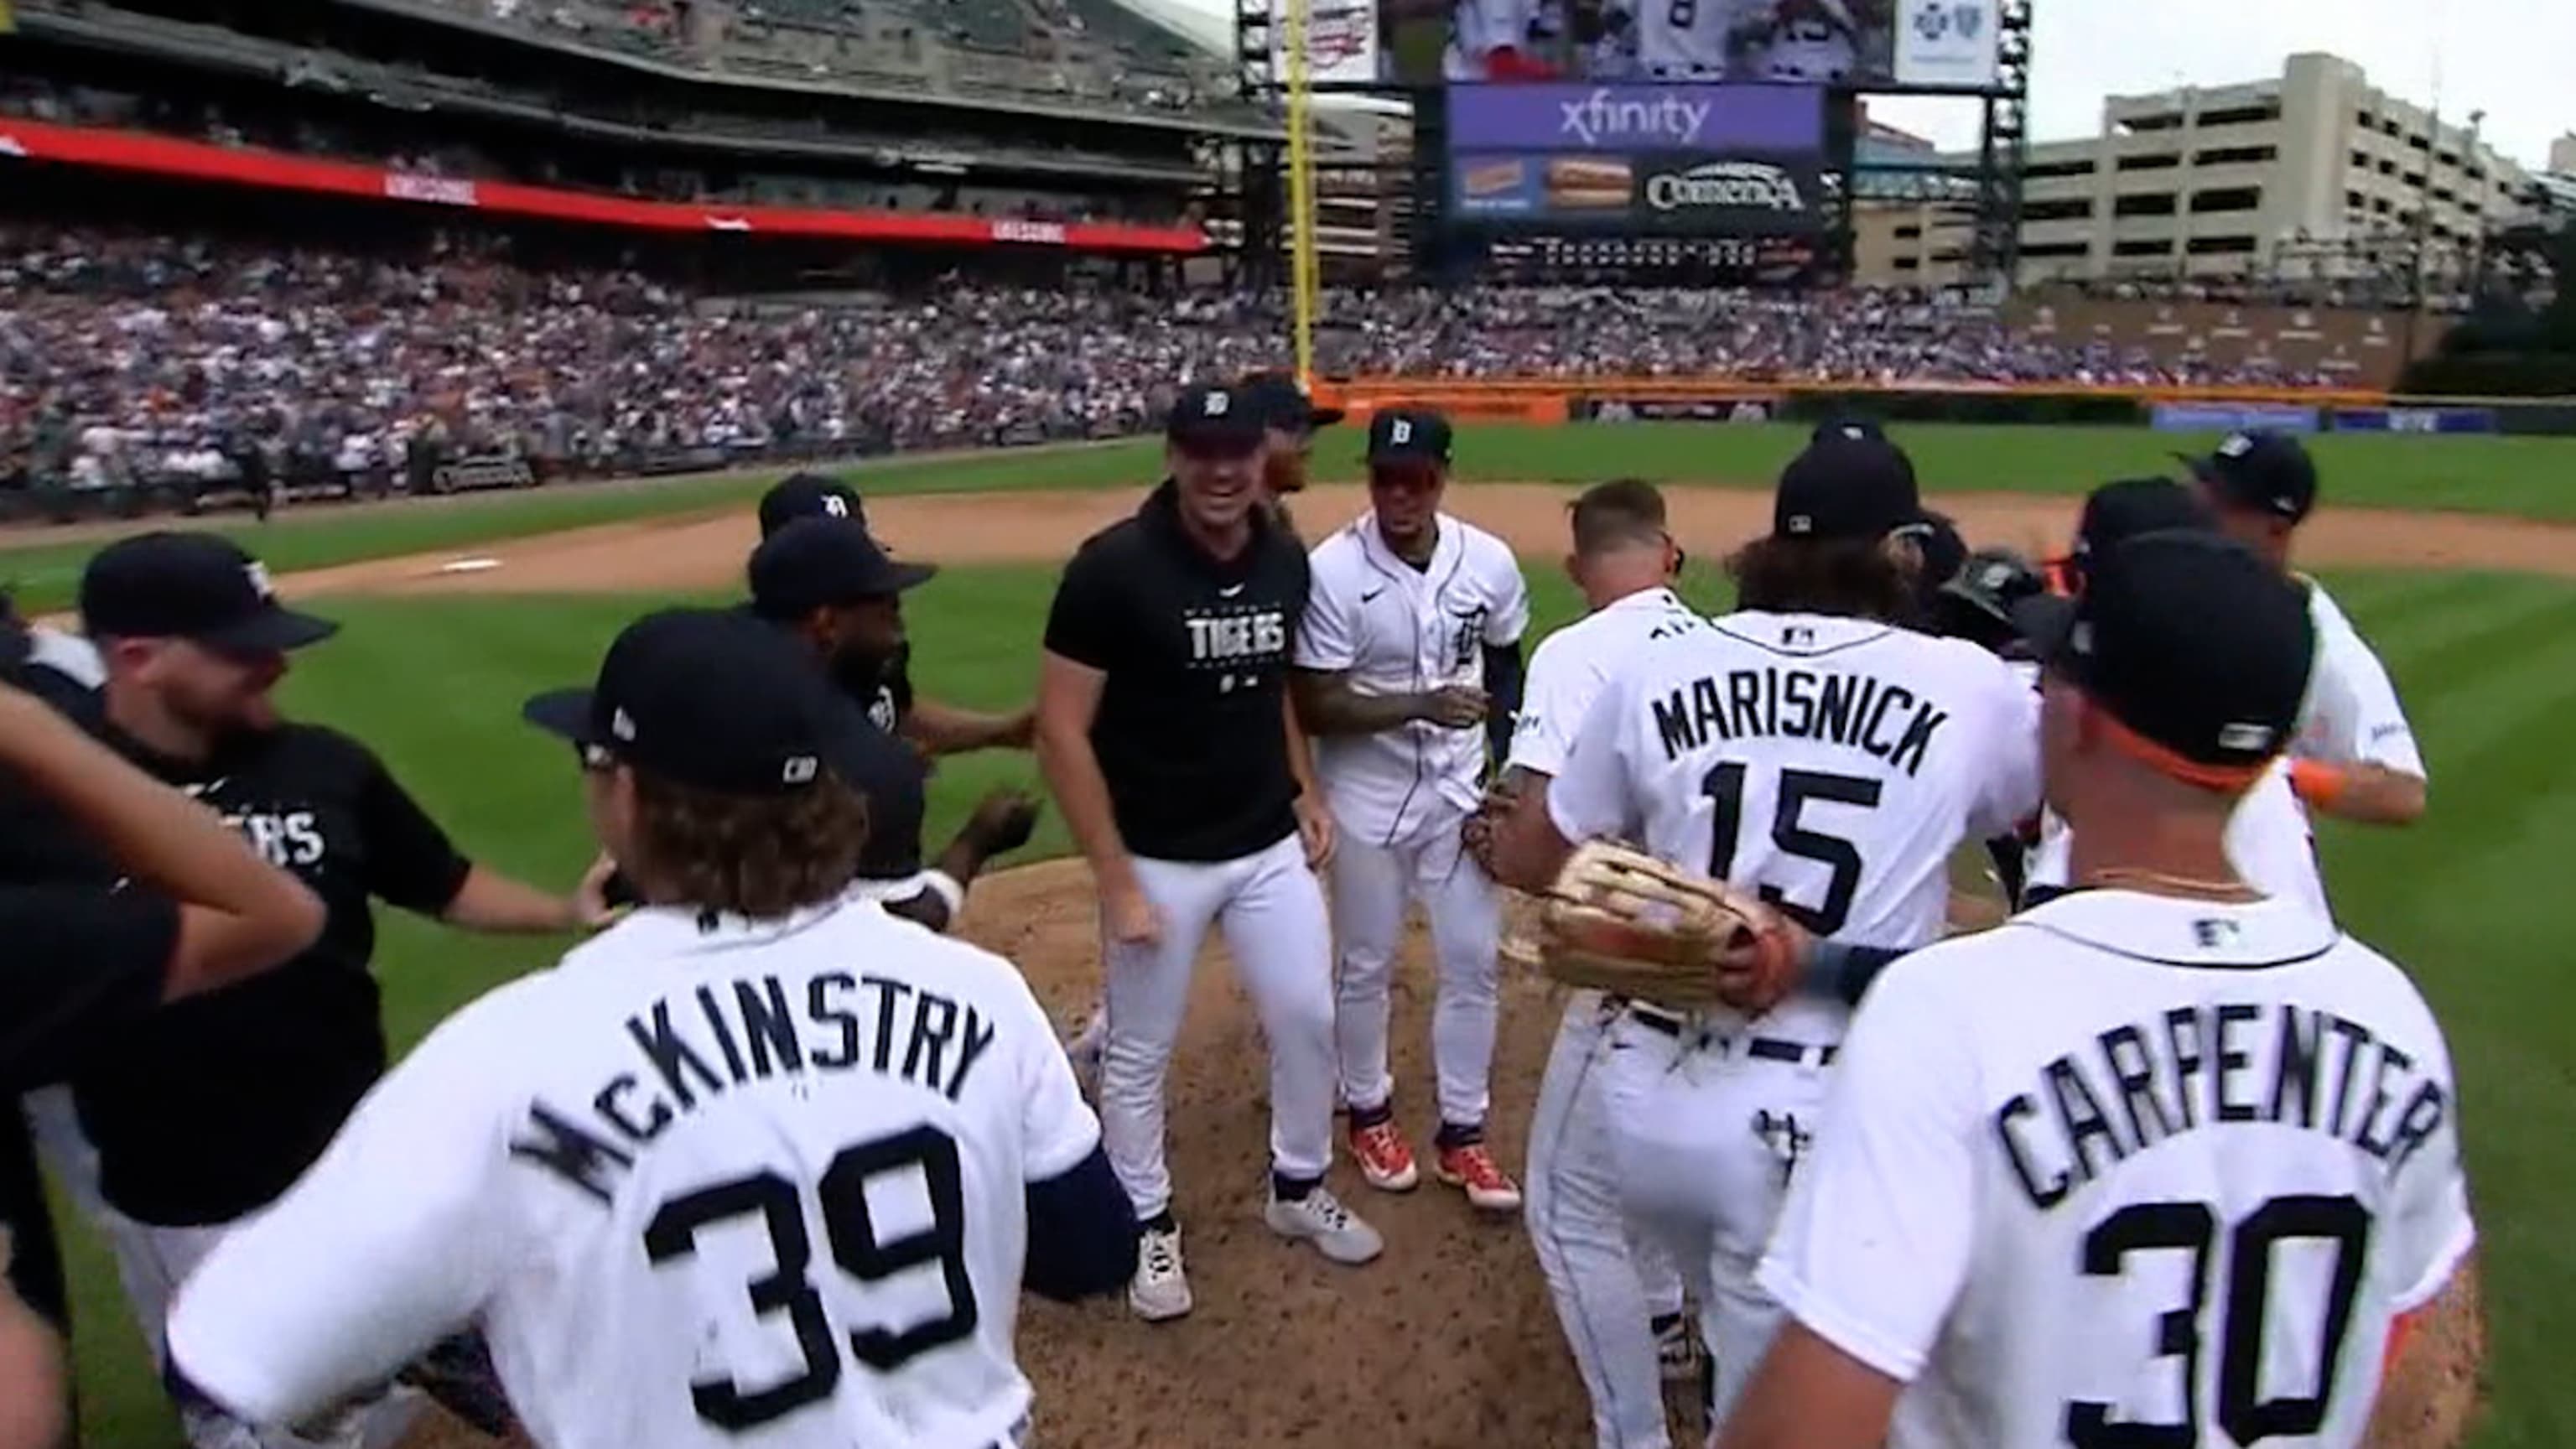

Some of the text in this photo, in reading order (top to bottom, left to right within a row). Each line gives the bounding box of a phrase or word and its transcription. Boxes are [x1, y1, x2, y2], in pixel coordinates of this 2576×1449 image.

[1561, 89, 1710, 143] xfinity
[1392, 418, 1410, 444] D
[1186, 612, 1284, 659] TIGERS
[1652, 667, 1948, 778] MARISNICK
[1701, 760, 1883, 937] 15
[1996, 1005, 2444, 1209] CARPENTER
[644, 1122, 978, 1434] 39
[2065, 1194, 2373, 1449] 30
